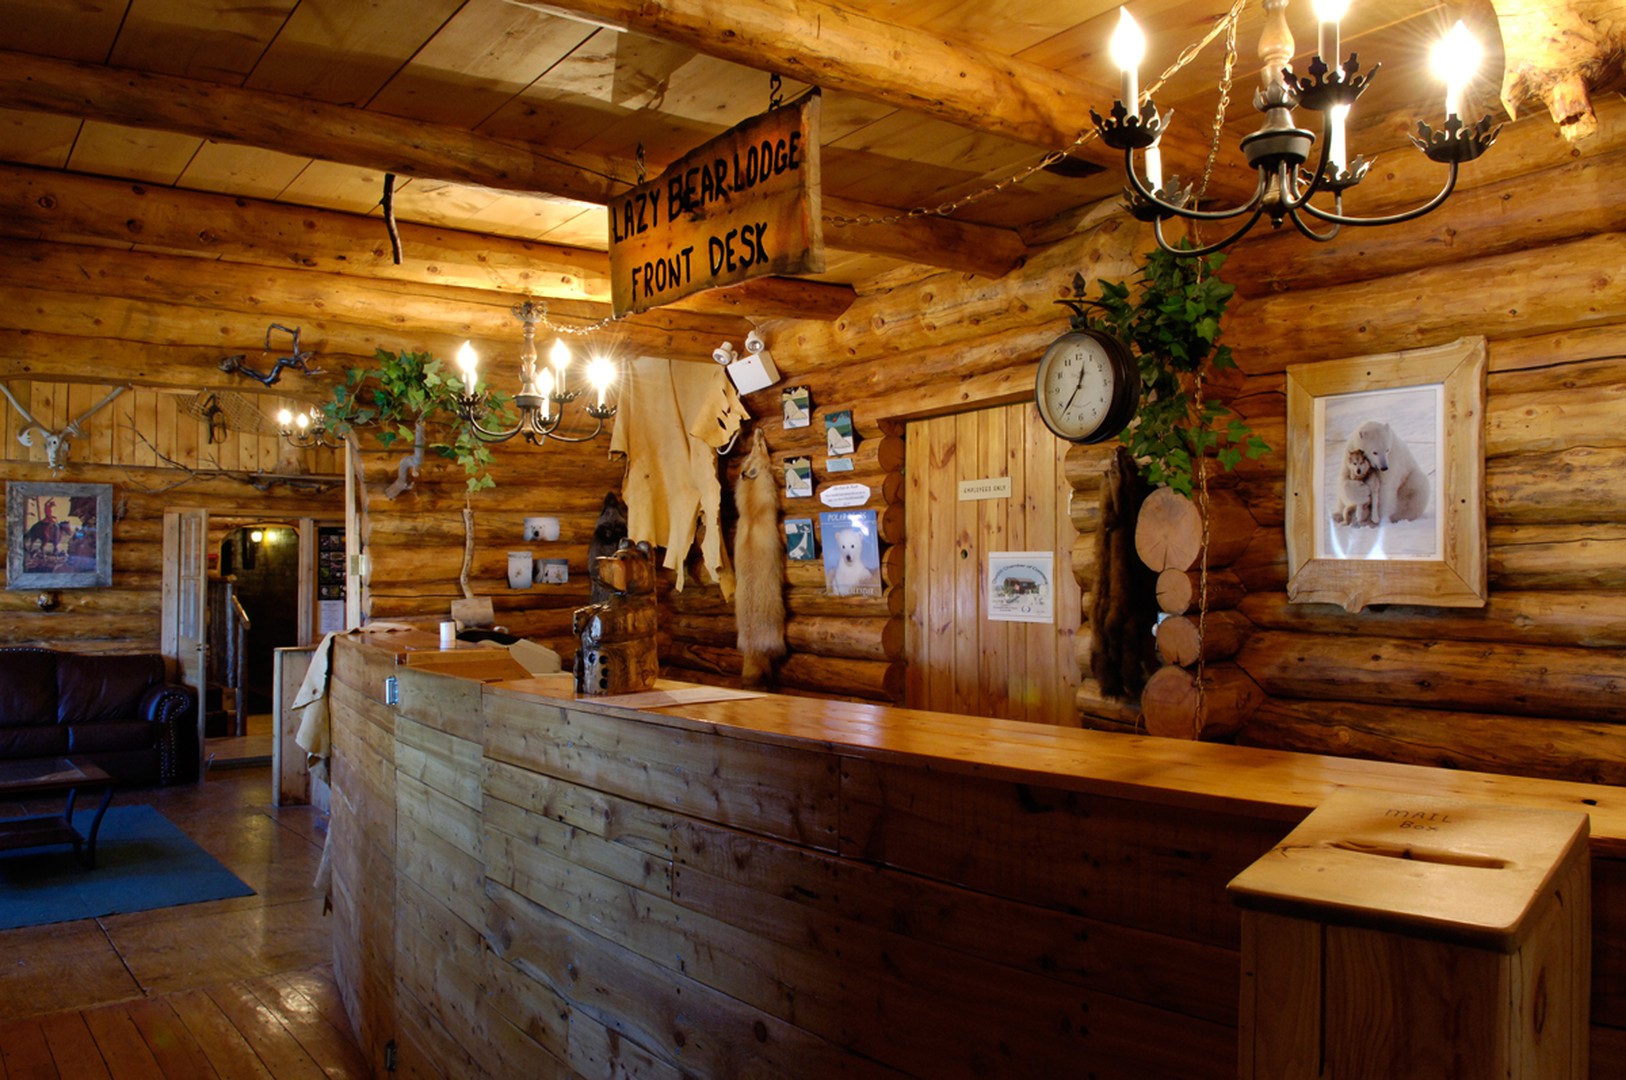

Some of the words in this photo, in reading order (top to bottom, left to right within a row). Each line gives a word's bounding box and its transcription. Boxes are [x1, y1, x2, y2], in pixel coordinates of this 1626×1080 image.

[612, 188, 661, 244] LAZY
[667, 157, 728, 223] BEAR
[733, 130, 802, 193] LODGE
[632, 246, 694, 302] FRONT
[708, 222, 769, 277] DESK
